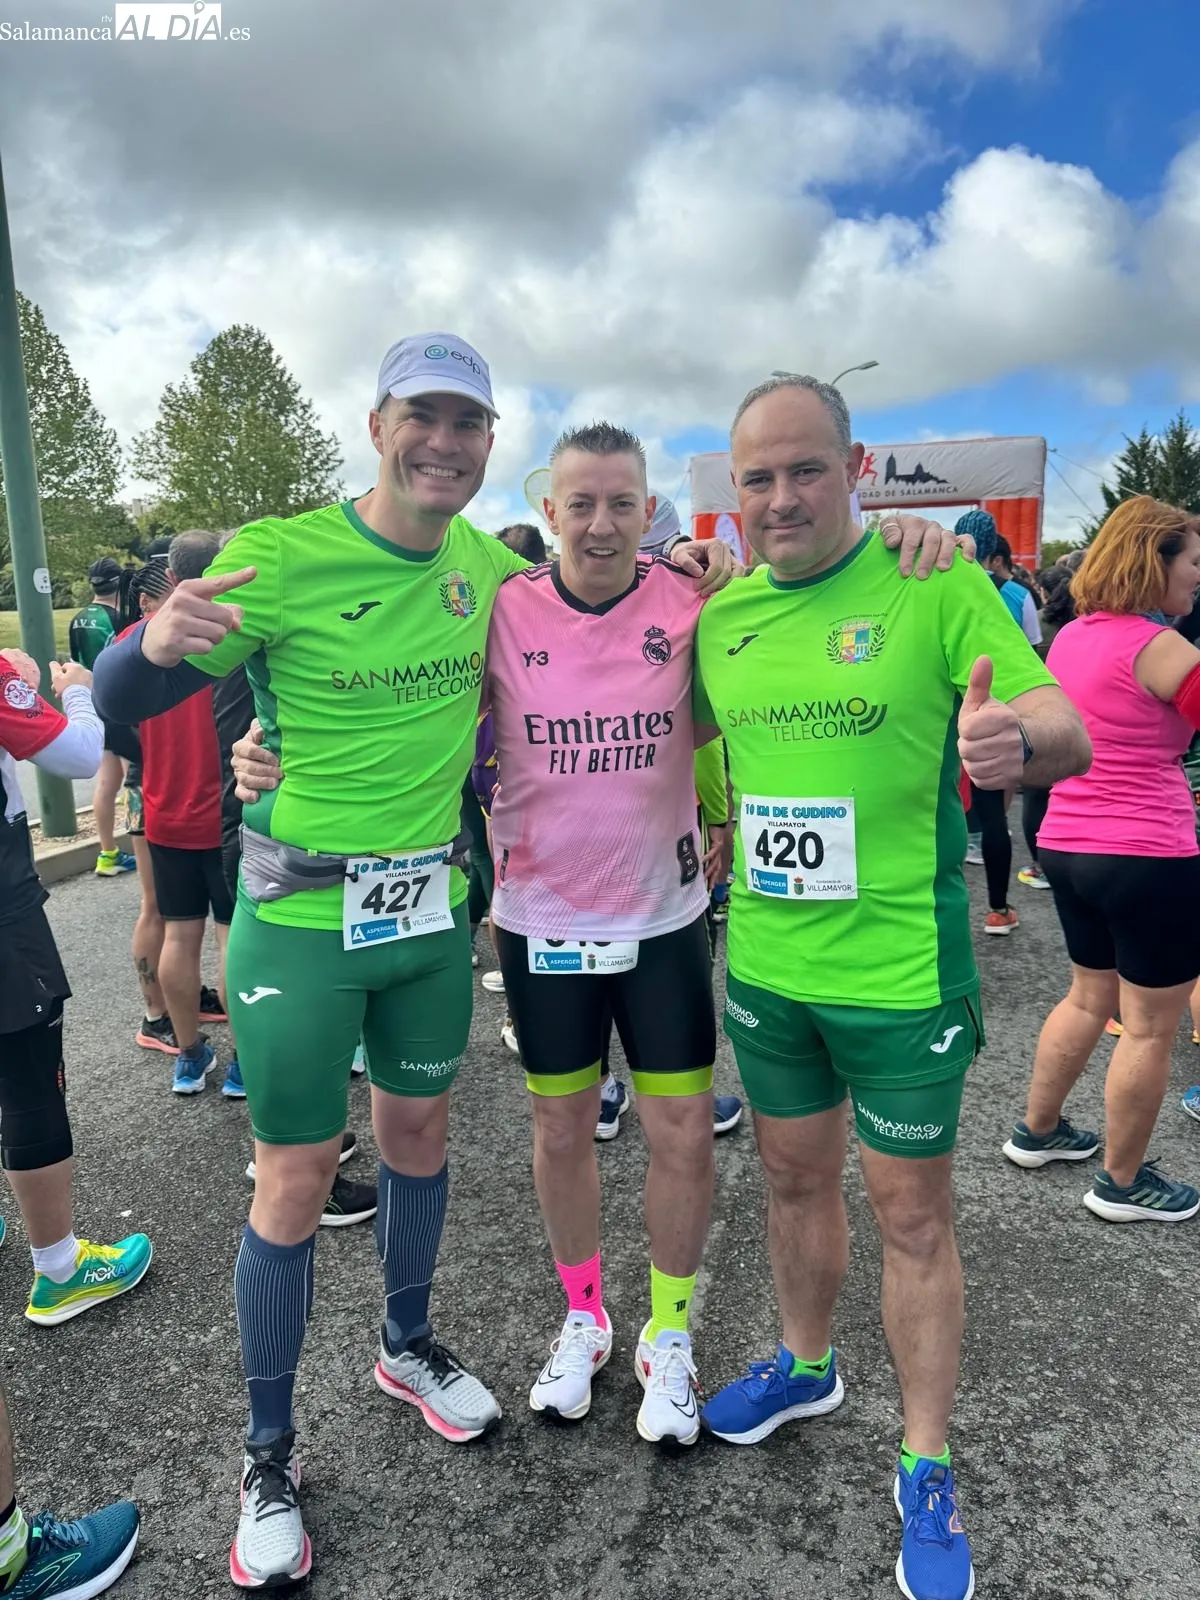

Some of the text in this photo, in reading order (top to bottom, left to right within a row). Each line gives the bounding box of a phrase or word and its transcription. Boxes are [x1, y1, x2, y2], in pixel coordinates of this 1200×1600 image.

[450, 350, 481, 375] edp
[885, 489, 896, 497] DE
[900, 486, 959, 497] SALAMANCA
[331, 651, 482, 690] SANMAXIMO
[392, 673, 478, 704] TELECOM
[727, 697, 868, 727] SANMAXIMO
[523, 709, 674, 745] Emirates
[769, 719, 857, 742] TELECOM
[549, 743, 657, 774] FLY BETTER
[745, 803, 755, 816] 10
[756, 804, 770, 817] KM
[772, 806, 789, 818] DE
[767, 820, 807, 828] VILLAMAYOR
[755, 828, 825, 870] 420
[353, 862, 370, 875] 10
[392, 858, 409, 870] DE
[385, 868, 422, 878] VILLAMAYOR
[361, 874, 431, 915] 427
[807, 884, 853, 892] VILLAMAYOR
[412, 914, 449, 927] VILLAMAYOR
[598, 957, 634, 967] VILLAMAYOR
[726, 996, 753, 1020] MAXIMO
[857, 1102, 935, 1133] SANMAXIMO
[873, 1122, 928, 1140] TELECOM
[82, 1263, 128, 1284] HOKA
